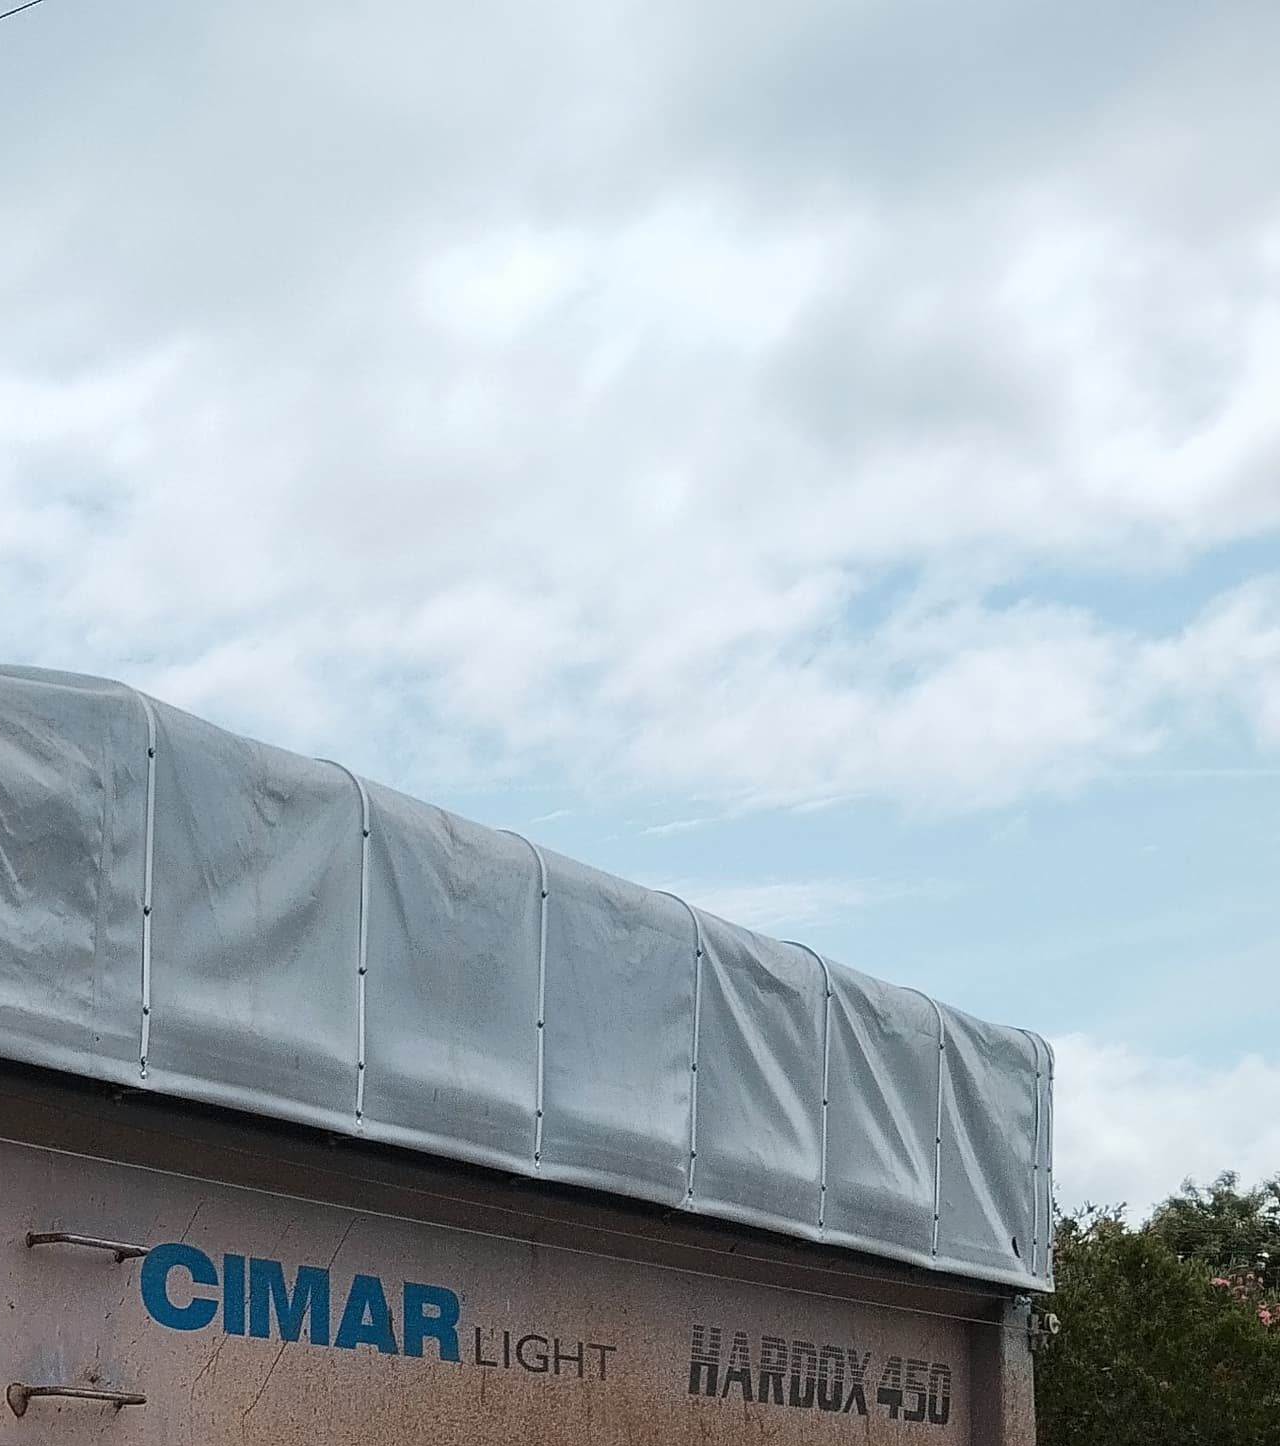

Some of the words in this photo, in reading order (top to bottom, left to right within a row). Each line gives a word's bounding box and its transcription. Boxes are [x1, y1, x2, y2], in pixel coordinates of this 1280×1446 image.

[141, 1243, 462, 1363] CIMAR
[473, 1325, 617, 1382] LIGHT
[688, 1324, 872, 1416] HARDOX
[877, 1356, 952, 1425] 450
